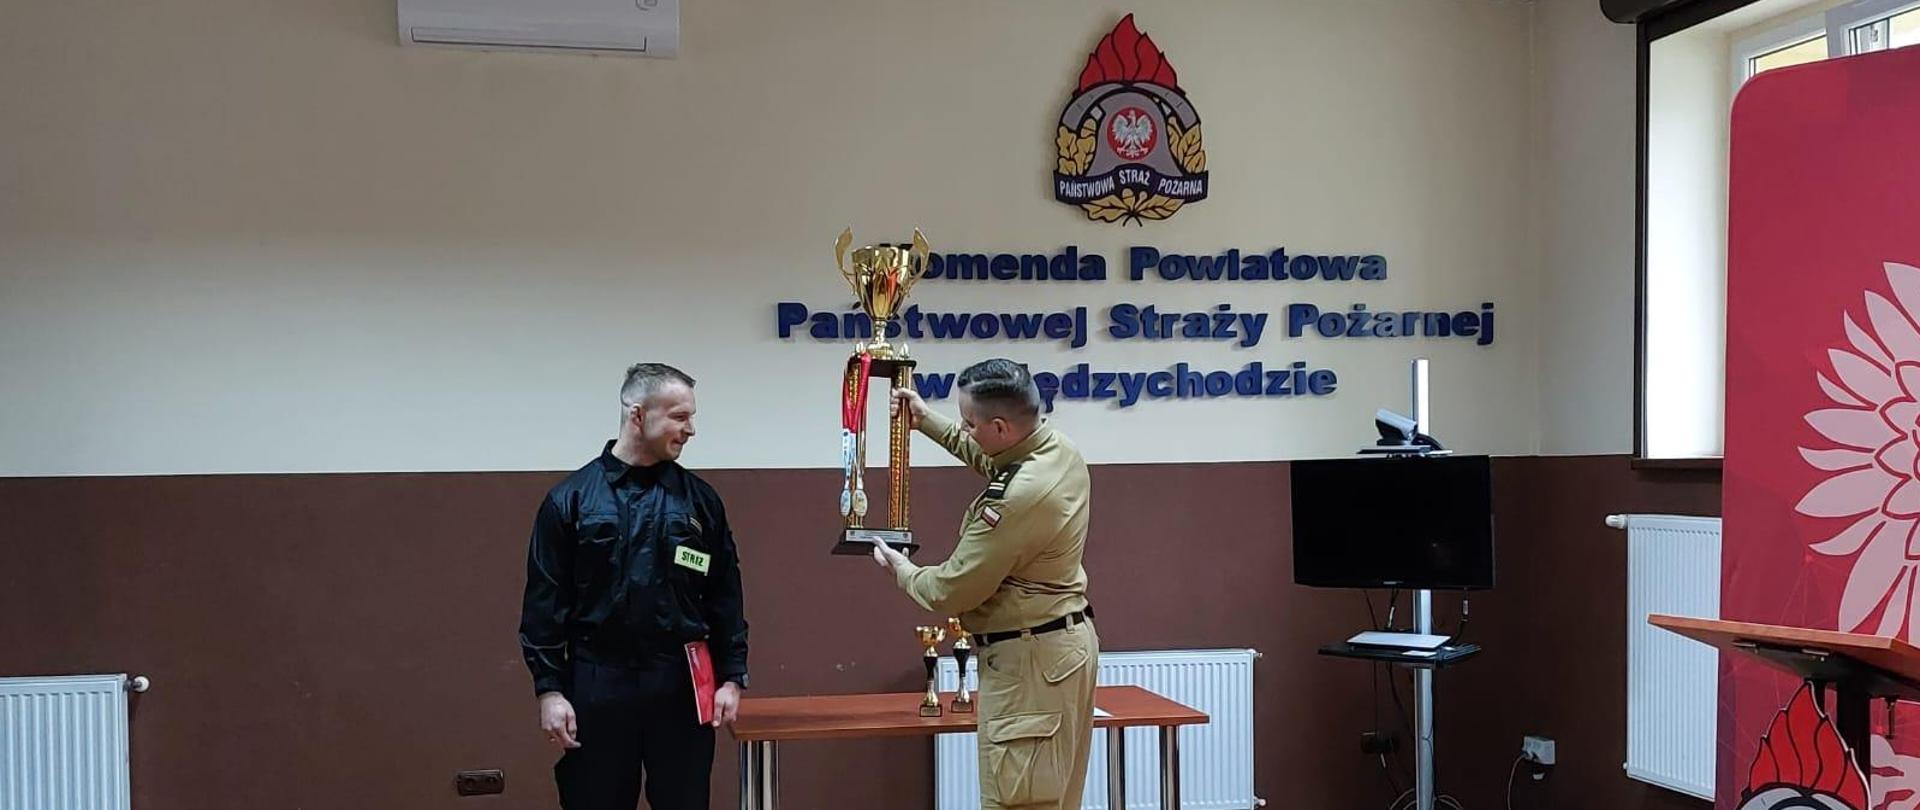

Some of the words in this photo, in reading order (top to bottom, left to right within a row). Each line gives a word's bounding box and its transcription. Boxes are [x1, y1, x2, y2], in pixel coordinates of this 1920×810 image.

[1060, 176, 1115, 198] PAŃSTWOWA
[880, 243, 1107, 282] omenda
[1108, 303, 1269, 348] Straży
[1287, 302, 1495, 346] Pożarnej
[913, 372, 956, 399] w
[1023, 362, 1338, 414] ędzychodzie
